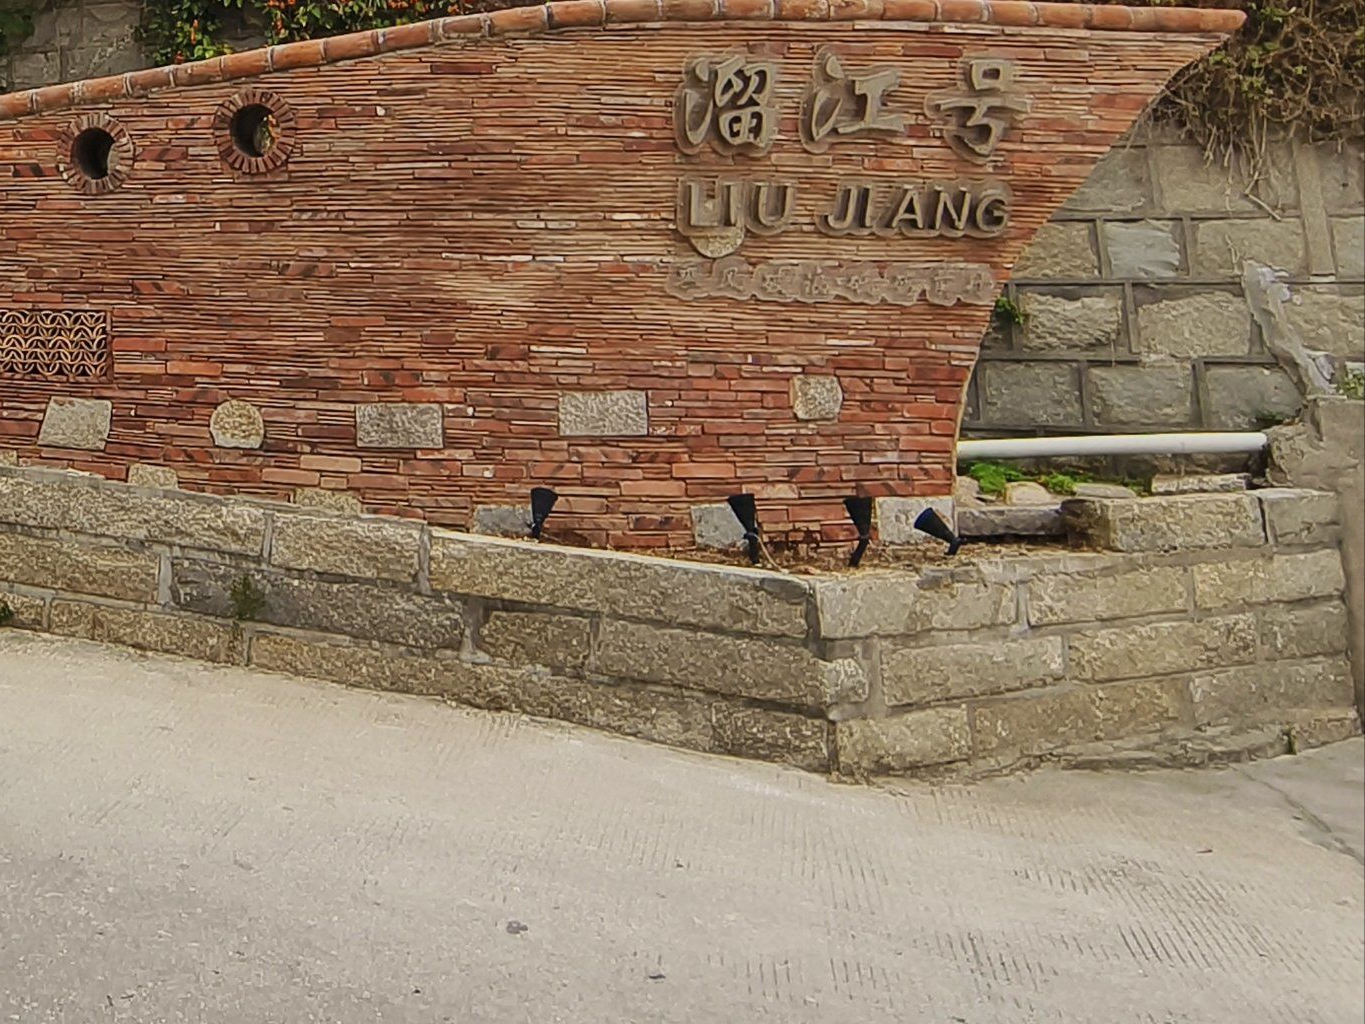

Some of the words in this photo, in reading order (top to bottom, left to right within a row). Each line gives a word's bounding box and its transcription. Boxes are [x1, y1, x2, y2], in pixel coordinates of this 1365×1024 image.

[679, 50, 1032, 159] 溜江号
[686, 180, 796, 229] LIU
[821, 183, 1011, 231] JIANG
